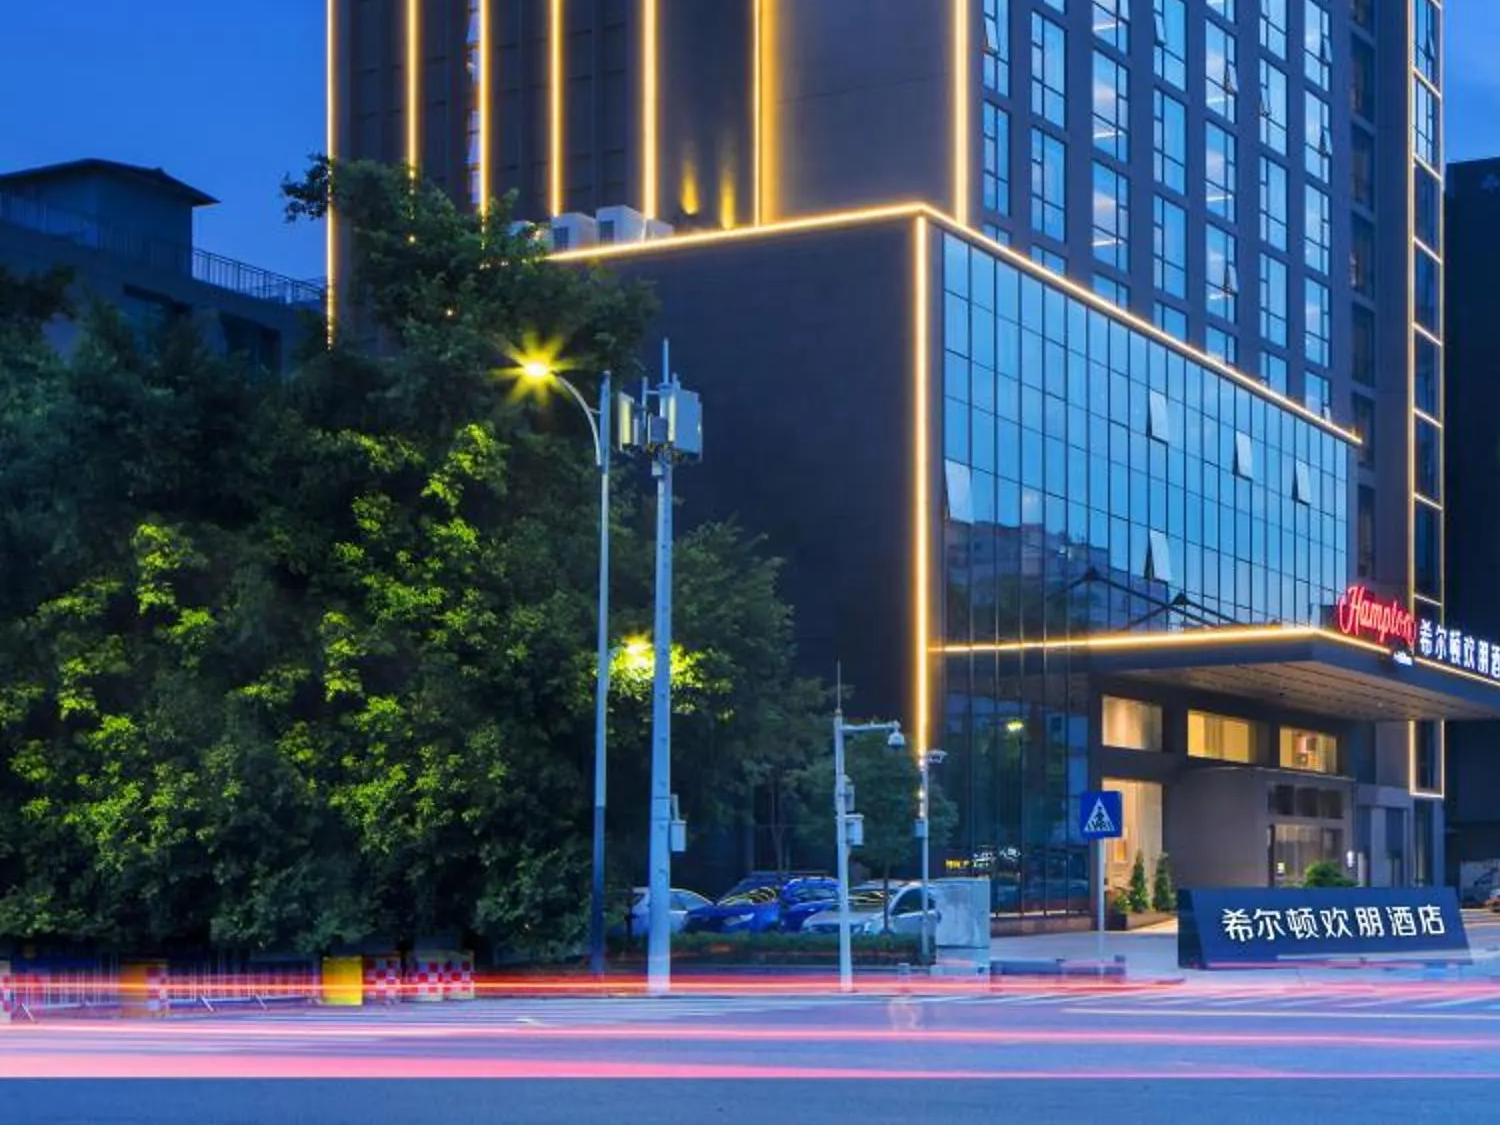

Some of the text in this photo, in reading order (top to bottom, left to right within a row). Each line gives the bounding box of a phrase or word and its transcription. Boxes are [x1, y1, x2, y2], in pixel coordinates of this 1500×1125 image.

[1337, 585, 1417, 651] Hampton
[1221, 904, 1446, 942] 希尔顿欢朋酒店
